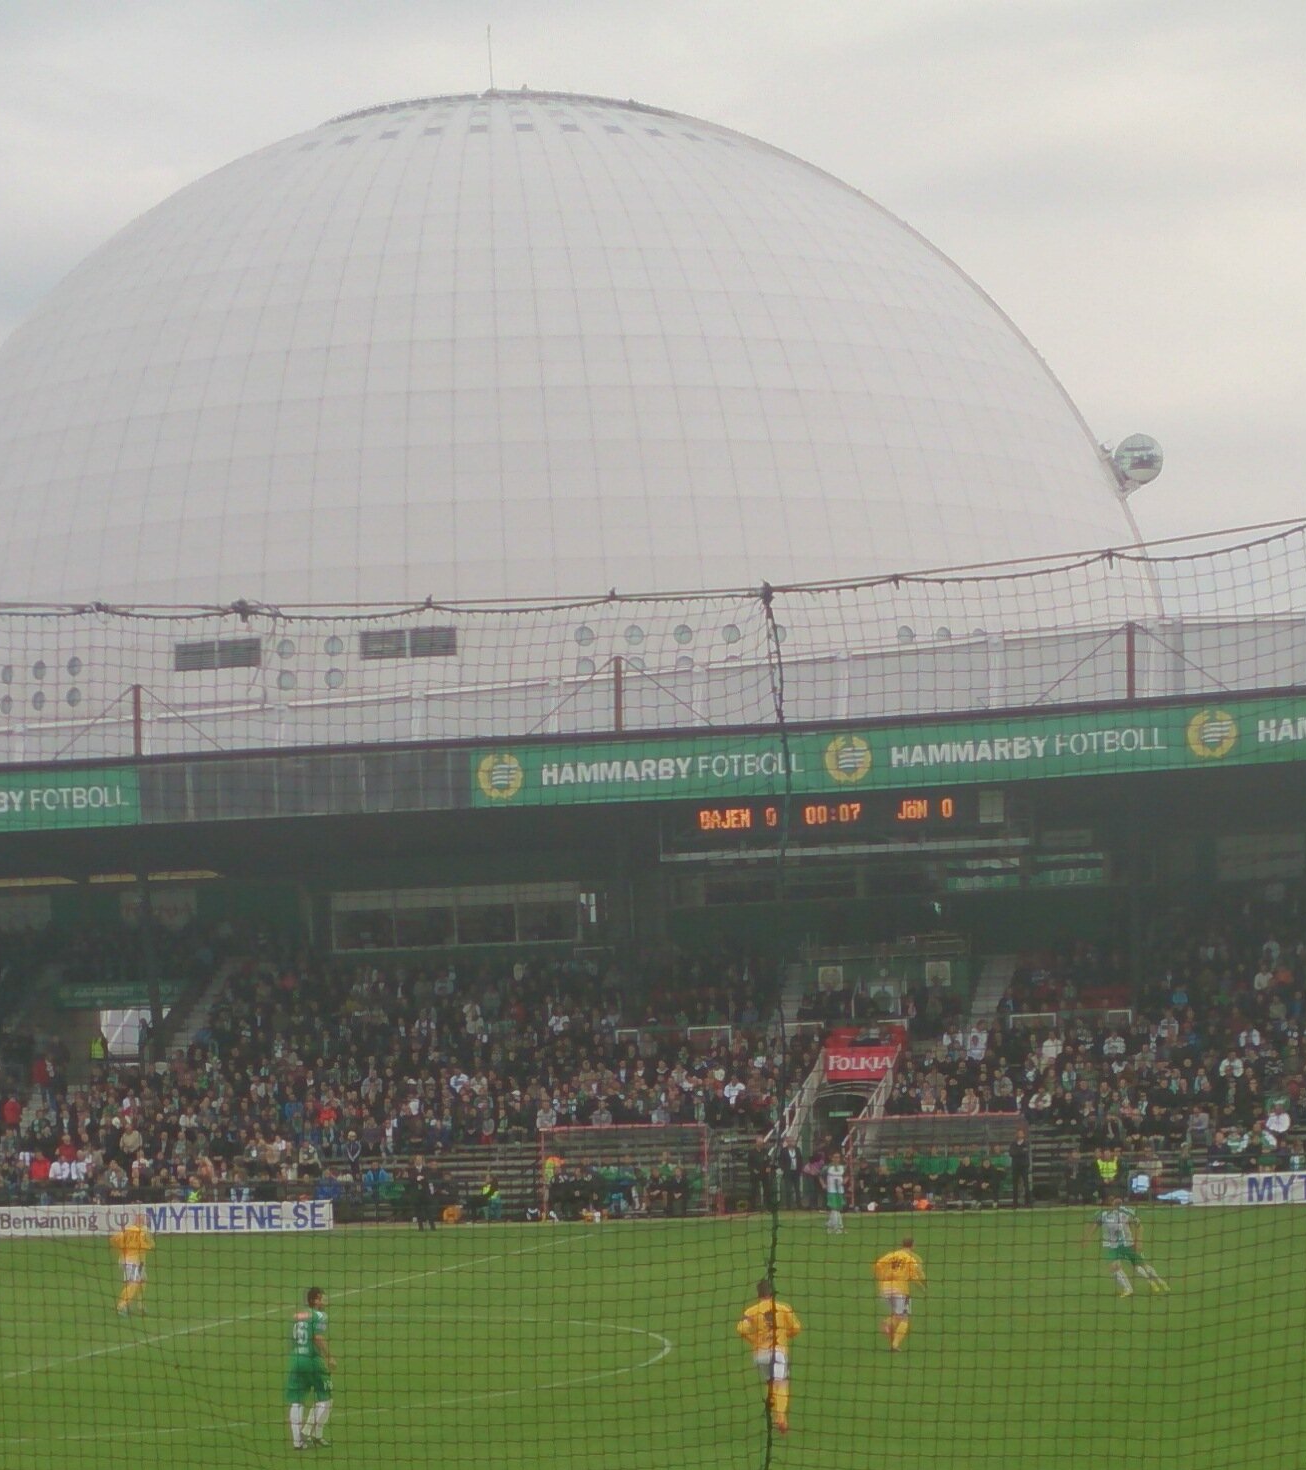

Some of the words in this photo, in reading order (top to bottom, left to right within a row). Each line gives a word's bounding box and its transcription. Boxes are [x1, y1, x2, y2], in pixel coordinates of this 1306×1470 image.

[891, 736, 1050, 768] HAMMARBY
[1055, 728, 1168, 758] FOTBOLL
[542, 757, 692, 786] HAMMARBY
[698, 750, 805, 779] FOTBOLL
[29, 785, 131, 812] FOTBOLL
[941, 798, 954, 818] 0
[700, 809, 751, 830] BAJEN
[766, 807, 777, 827] 0
[805, 803, 861, 826] 00:07
[0, 1210, 99, 1231] Bemanning
[146, 1202, 327, 1232] MYTILENE.SE
